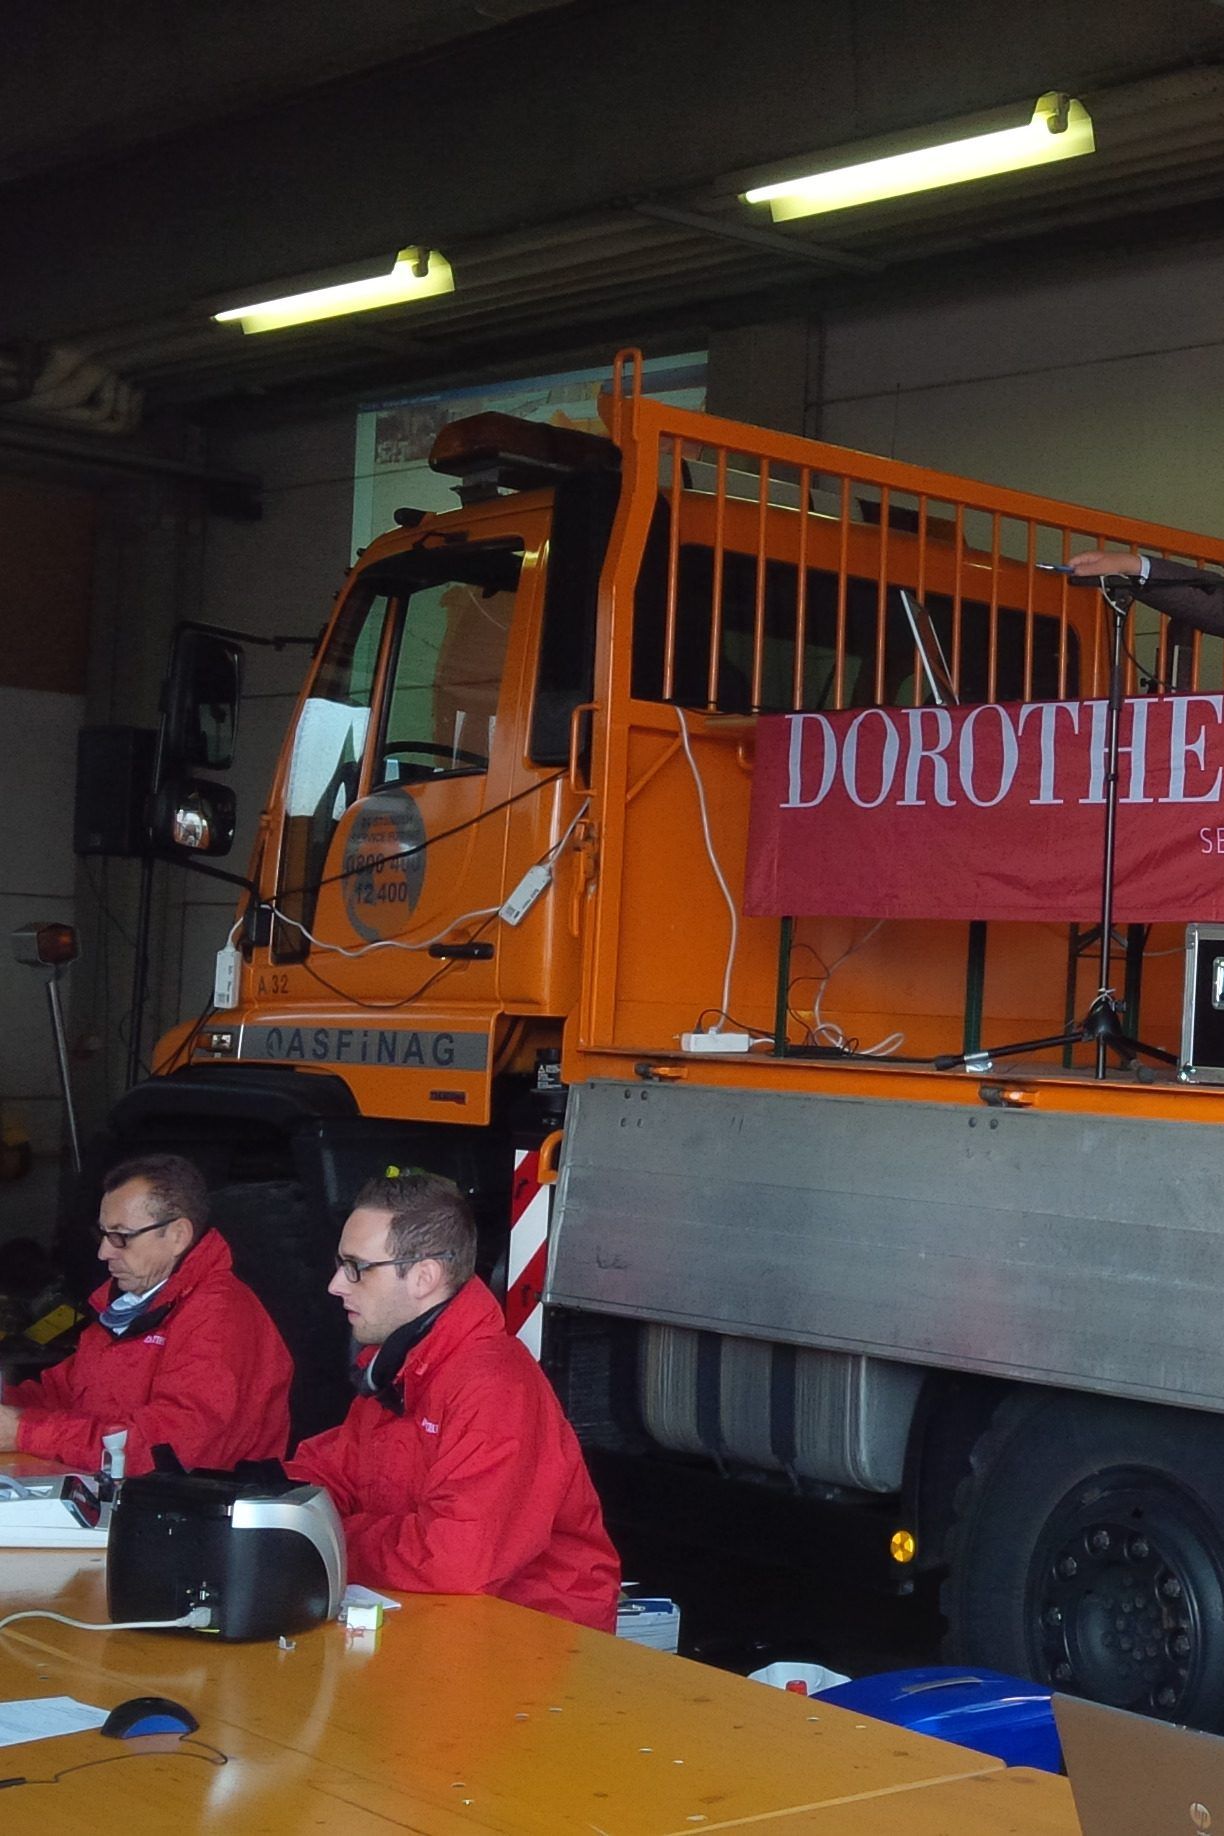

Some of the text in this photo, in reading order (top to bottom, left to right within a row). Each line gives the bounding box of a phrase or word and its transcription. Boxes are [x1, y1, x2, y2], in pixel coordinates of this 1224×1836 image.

[377, 881, 407, 903] 400
[258, 974, 289, 994] A 32
